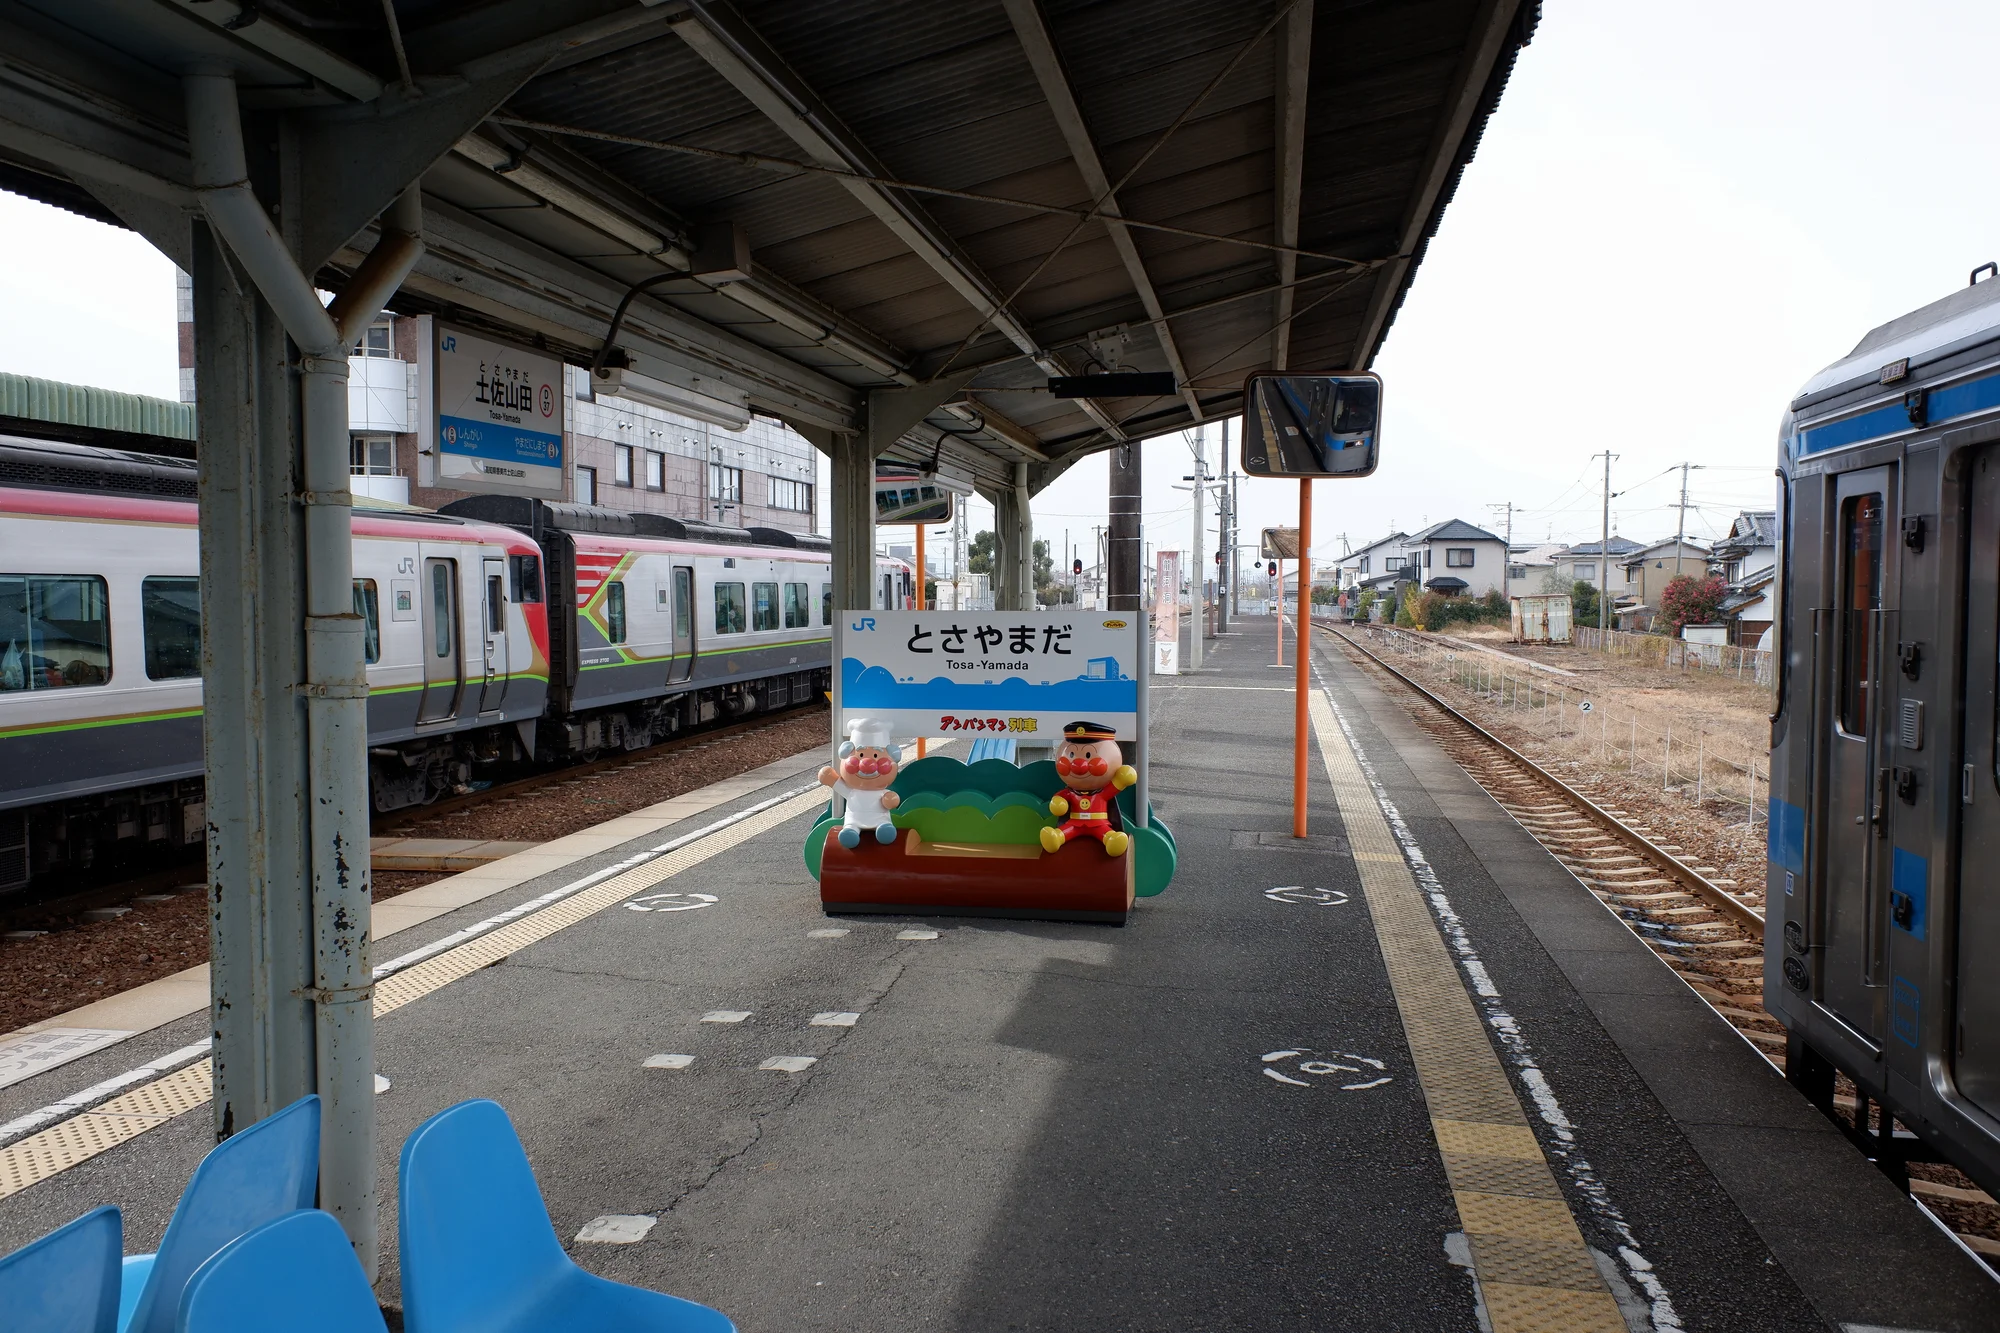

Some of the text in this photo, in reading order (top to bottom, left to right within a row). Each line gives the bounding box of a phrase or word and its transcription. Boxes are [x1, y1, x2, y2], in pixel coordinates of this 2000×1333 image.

[442, 336, 456, 353] JR
[480, 360, 529, 383] とさやまだ
[475, 374, 532, 413] 土佐山田
[544, 389, 549, 400] D
[543, 401, 550, 411] 37
[489, 410, 521, 424] Tosa-Yamada
[458, 427, 483, 442] しんがい
[514, 436, 547, 452] やまだにしまち
[397, 558, 414, 574] JR
[852, 617, 876, 632] JR
[907, 623, 1072, 655] とさやまだ
[946, 659, 1029, 671] Tosa-Yamada
[1582, 702, 1591, 711] 2
[940, 715, 1038, 733] アンパンマン列車
